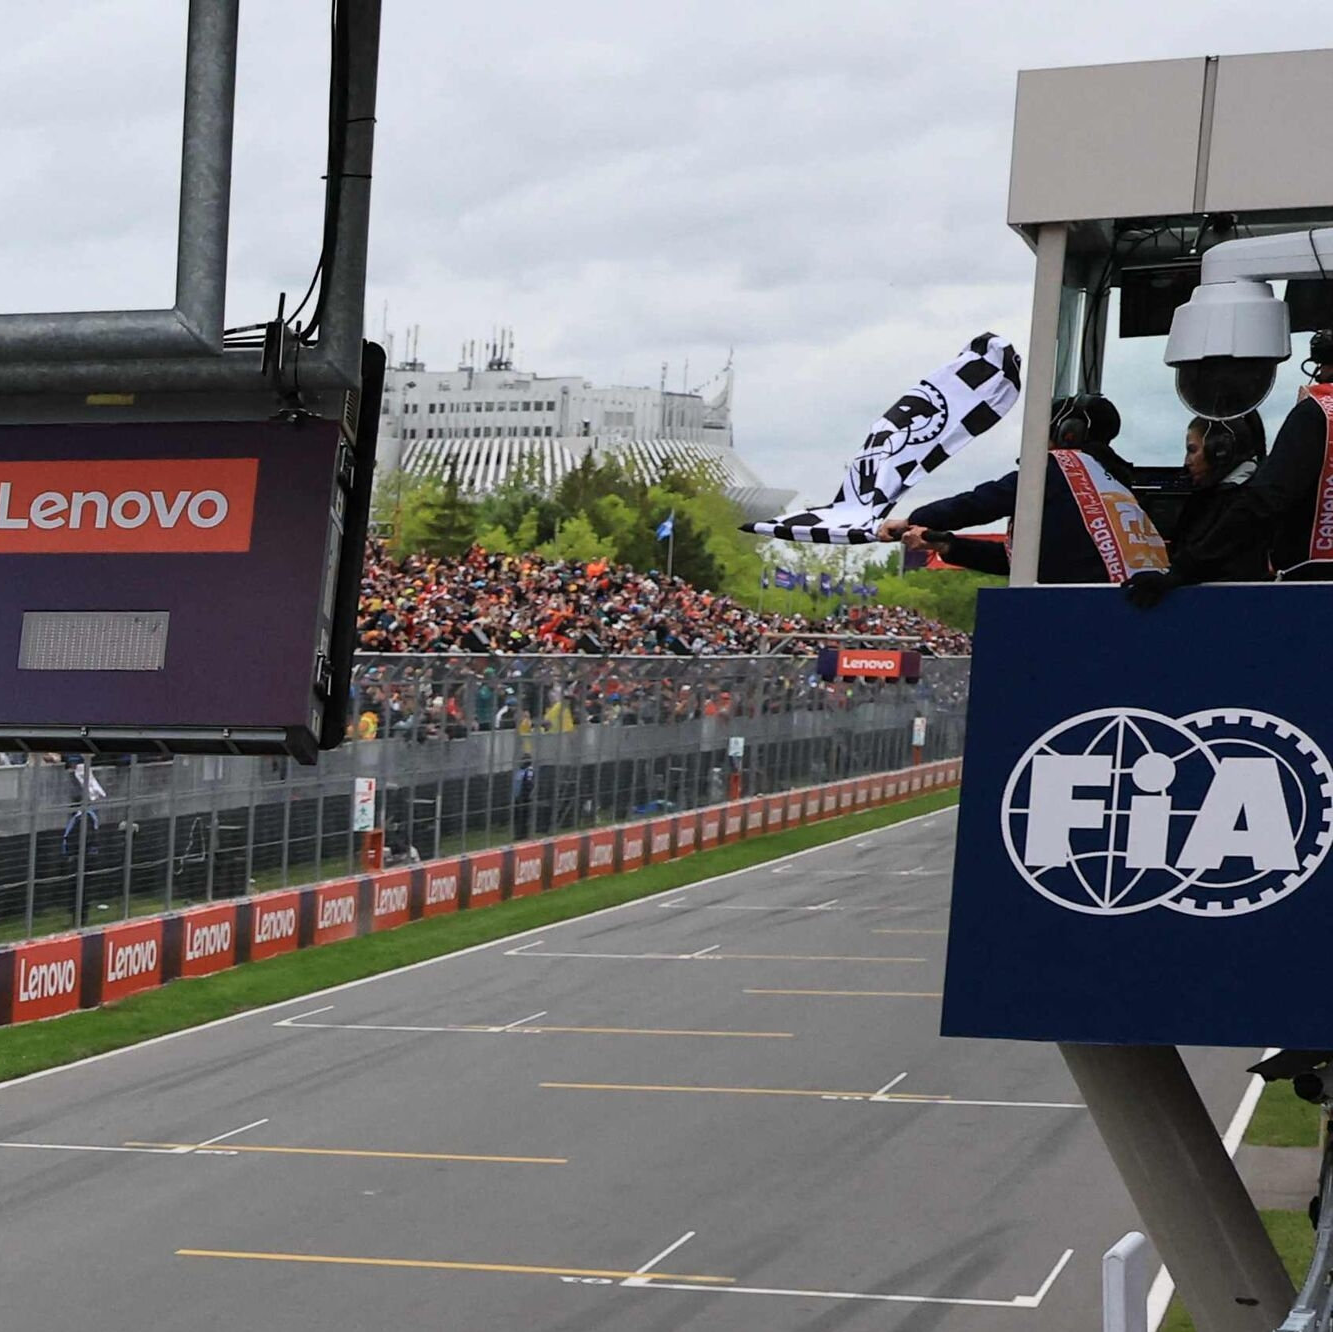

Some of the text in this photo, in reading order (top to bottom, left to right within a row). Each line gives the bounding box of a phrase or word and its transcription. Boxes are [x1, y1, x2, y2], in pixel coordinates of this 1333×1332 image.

[842, 656, 895, 670] Lenovo
[427, 874, 457, 904] Lenovo
[472, 865, 501, 895] Lenovo
[318, 894, 355, 930] Lenovo
[375, 883, 408, 915] Lenovo
[186, 922, 231, 961] Lenovo
[255, 907, 295, 943] Lenovo
[107, 940, 157, 981] Lenovo
[19, 959, 76, 1001] Lenovo
